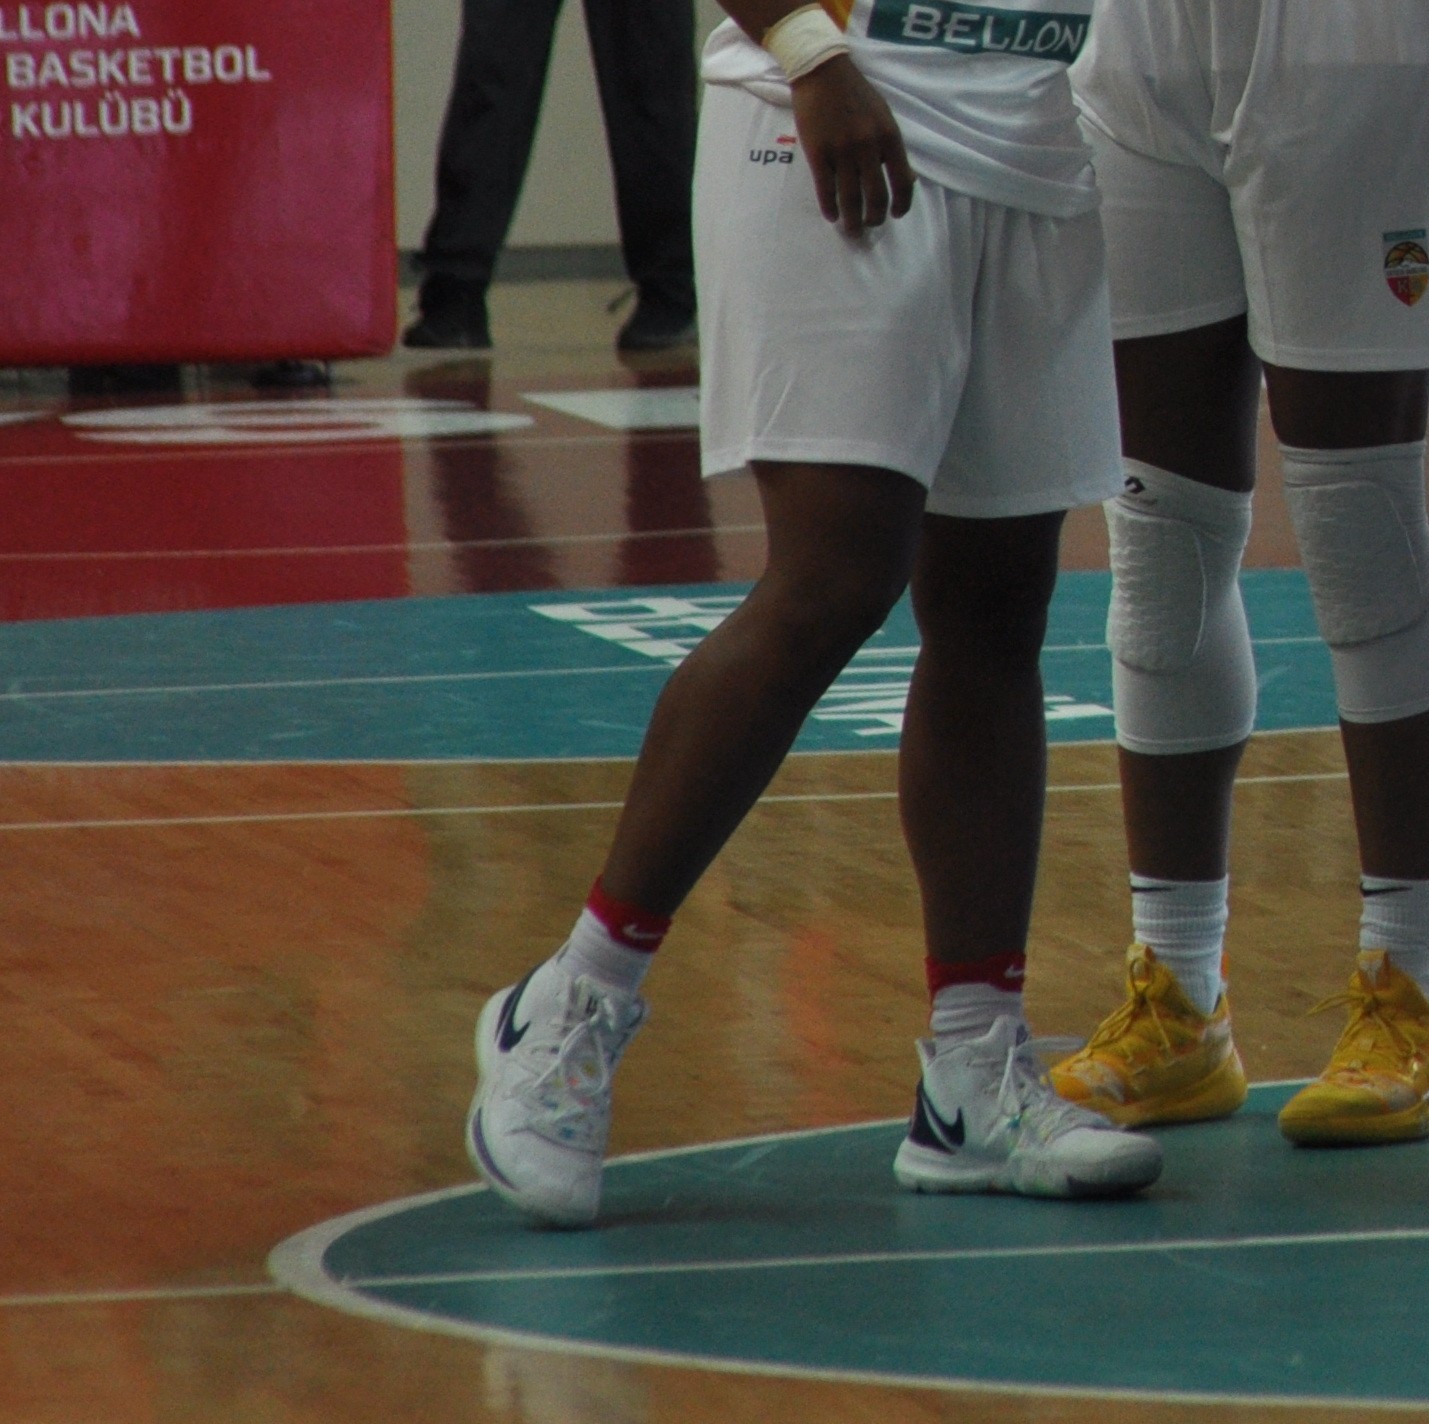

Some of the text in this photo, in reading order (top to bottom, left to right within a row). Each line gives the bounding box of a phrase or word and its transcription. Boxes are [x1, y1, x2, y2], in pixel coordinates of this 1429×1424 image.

[0, 0, 142, 42] LLONA
[5, 42, 274, 90] BASKETBOL
[10, 85, 194, 141] KULÜBÜ
[749, 149, 794, 166] upa
